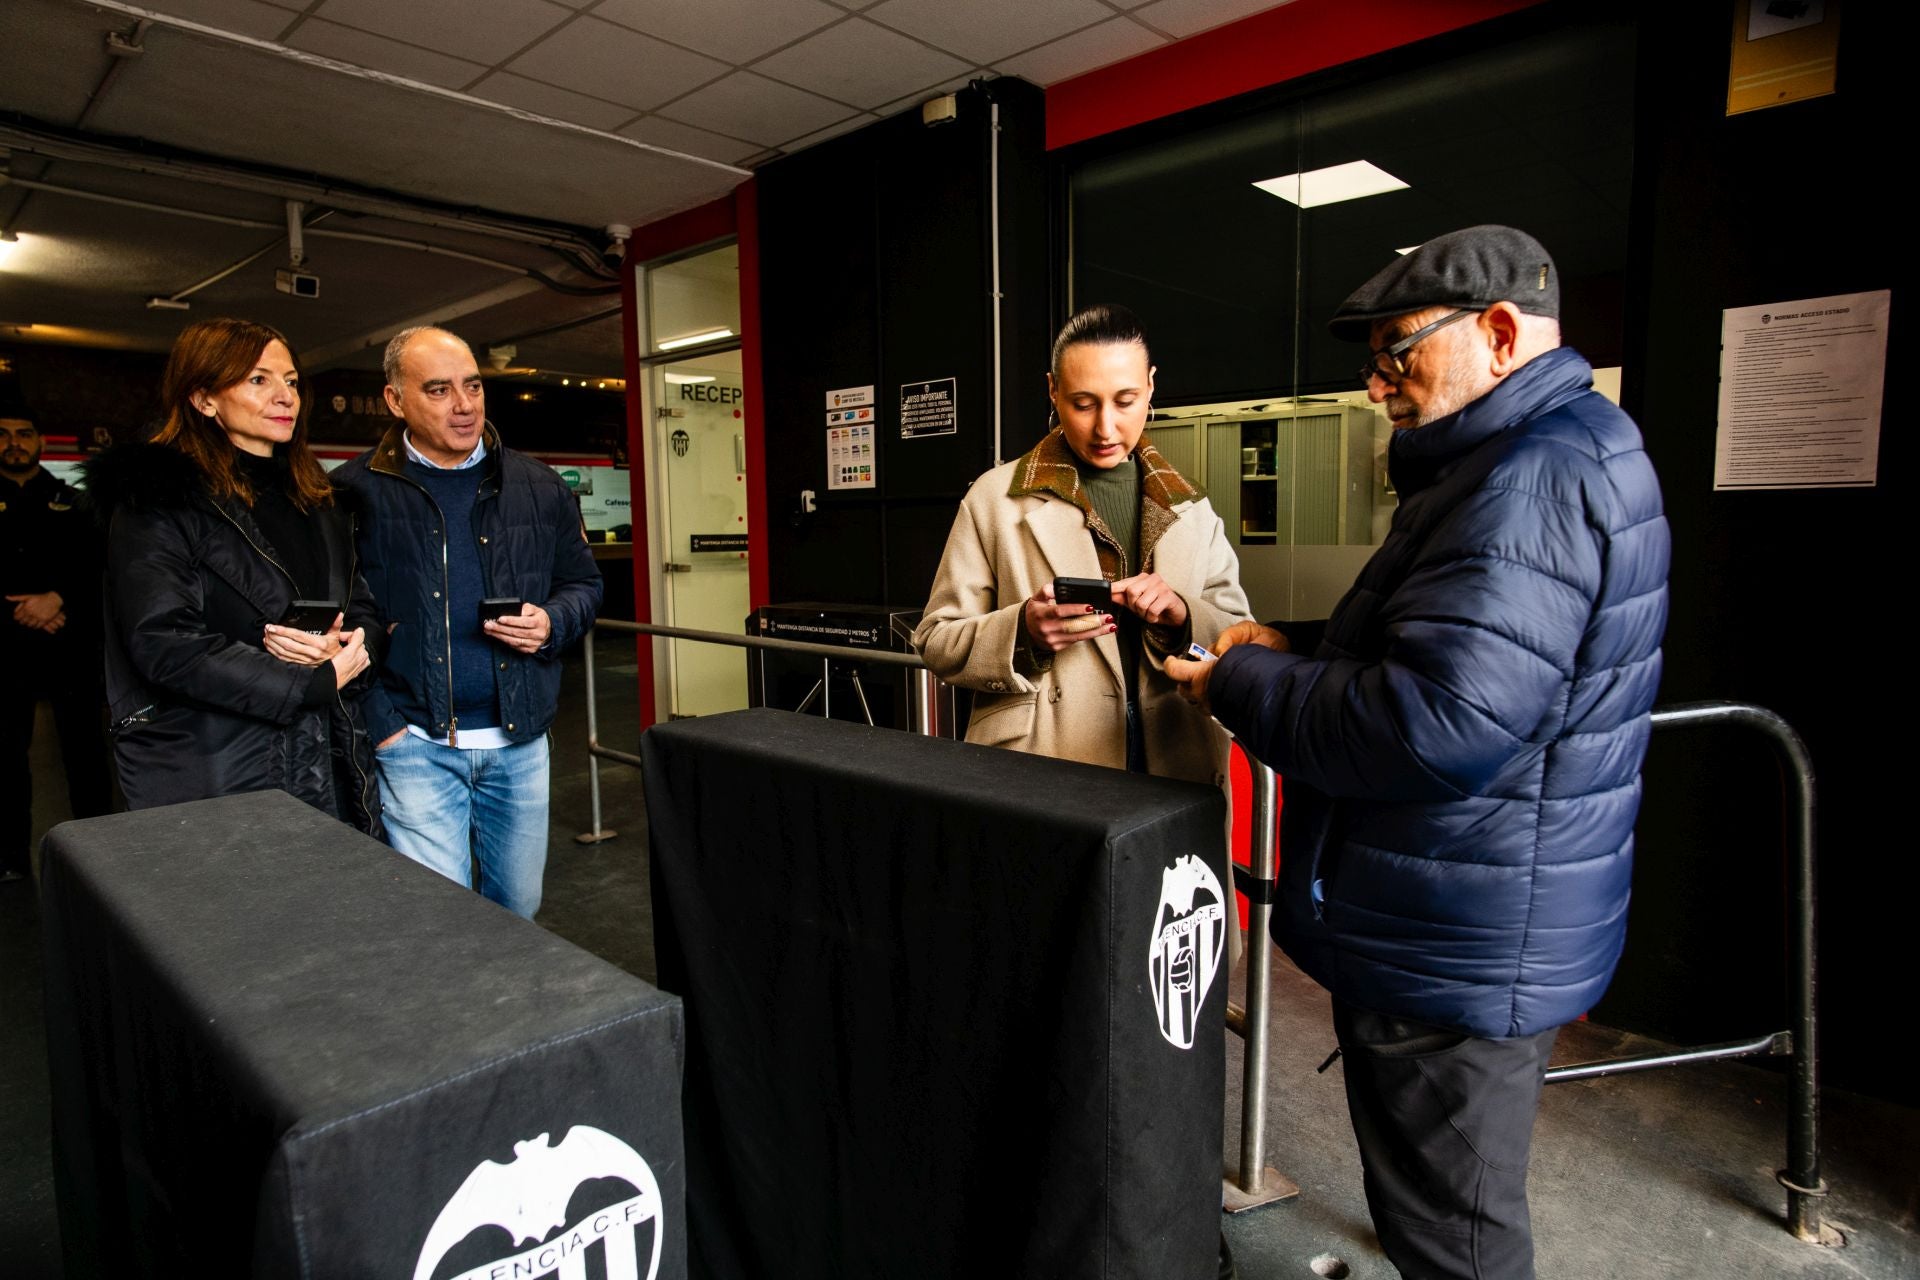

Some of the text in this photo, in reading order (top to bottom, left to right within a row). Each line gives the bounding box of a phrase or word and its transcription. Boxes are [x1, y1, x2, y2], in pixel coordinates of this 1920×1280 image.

[681, 384, 742, 404] RECEP
[907, 390, 948, 403] AVISO IMPORTANTE
[825, 627, 848, 635] SEGURIDAD
[593, 1203, 644, 1233] C.F.
